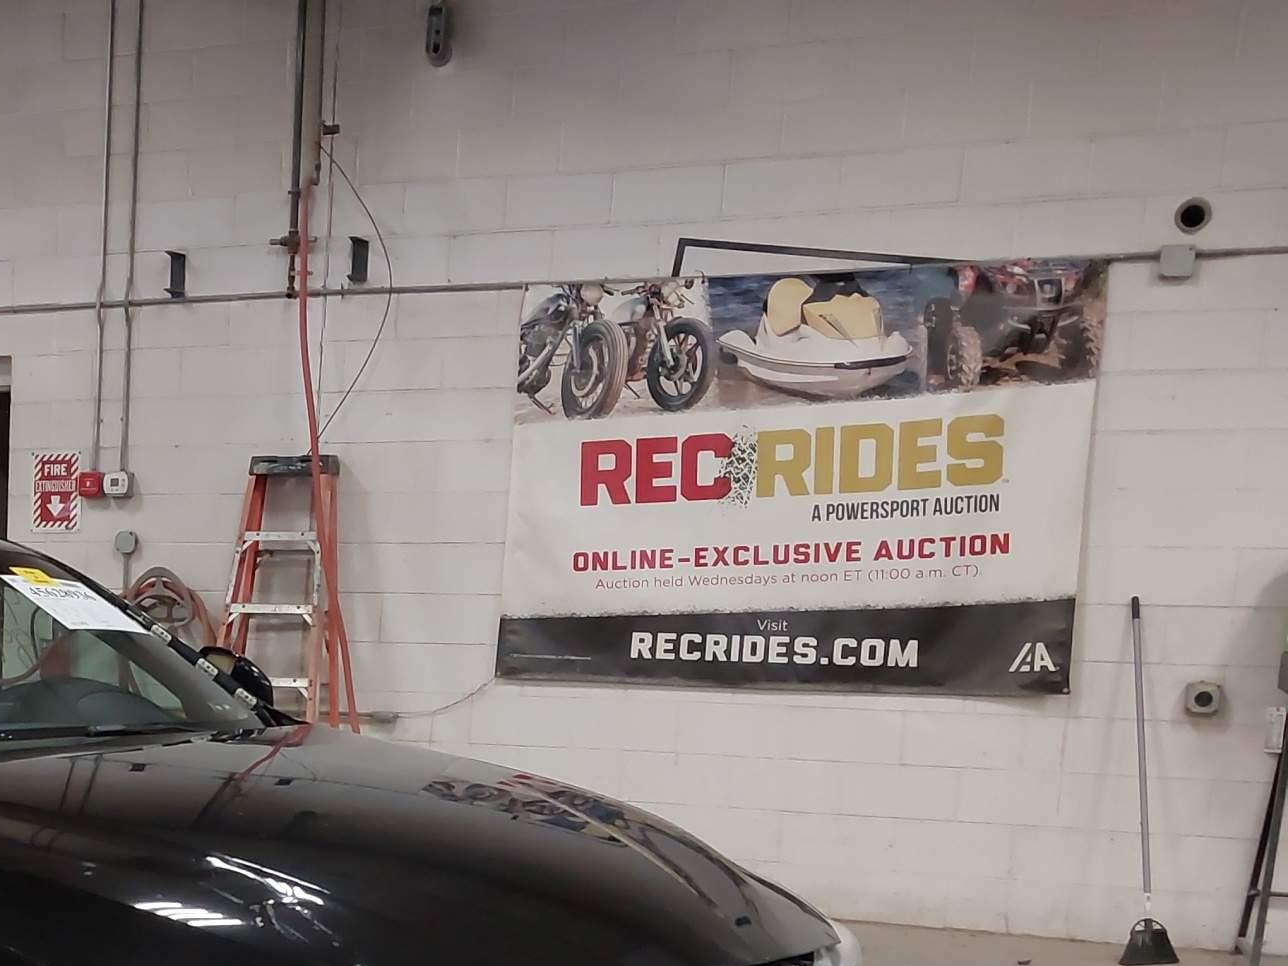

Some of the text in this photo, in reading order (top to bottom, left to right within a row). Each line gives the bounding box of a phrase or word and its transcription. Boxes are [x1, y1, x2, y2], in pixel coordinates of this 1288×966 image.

[755, 414, 1005, 498] RIDES
[44, 463, 68, 476] FIRE
[35, 480, 76, 492] EXTINGUISHER
[811, 493, 1001, 522] A POWERSPORT AUCTION
[572, 533, 1011, 572] ONLINE-EXCLUSIVE AUCTION
[595, 577, 649, 590] Auction
[654, 575, 683, 588] held
[688, 572, 778, 587] Wednesdays
[782, 572, 796, 583] at
[801, 572, 838, 583] noon
[843, 570, 862, 582] ET
[868, 567, 911, 583] (11:00
[915, 567, 946, 580] a.m.
[757, 619, 788, 632] Visit
[630, 632, 918, 667] RECRIDES.COM
